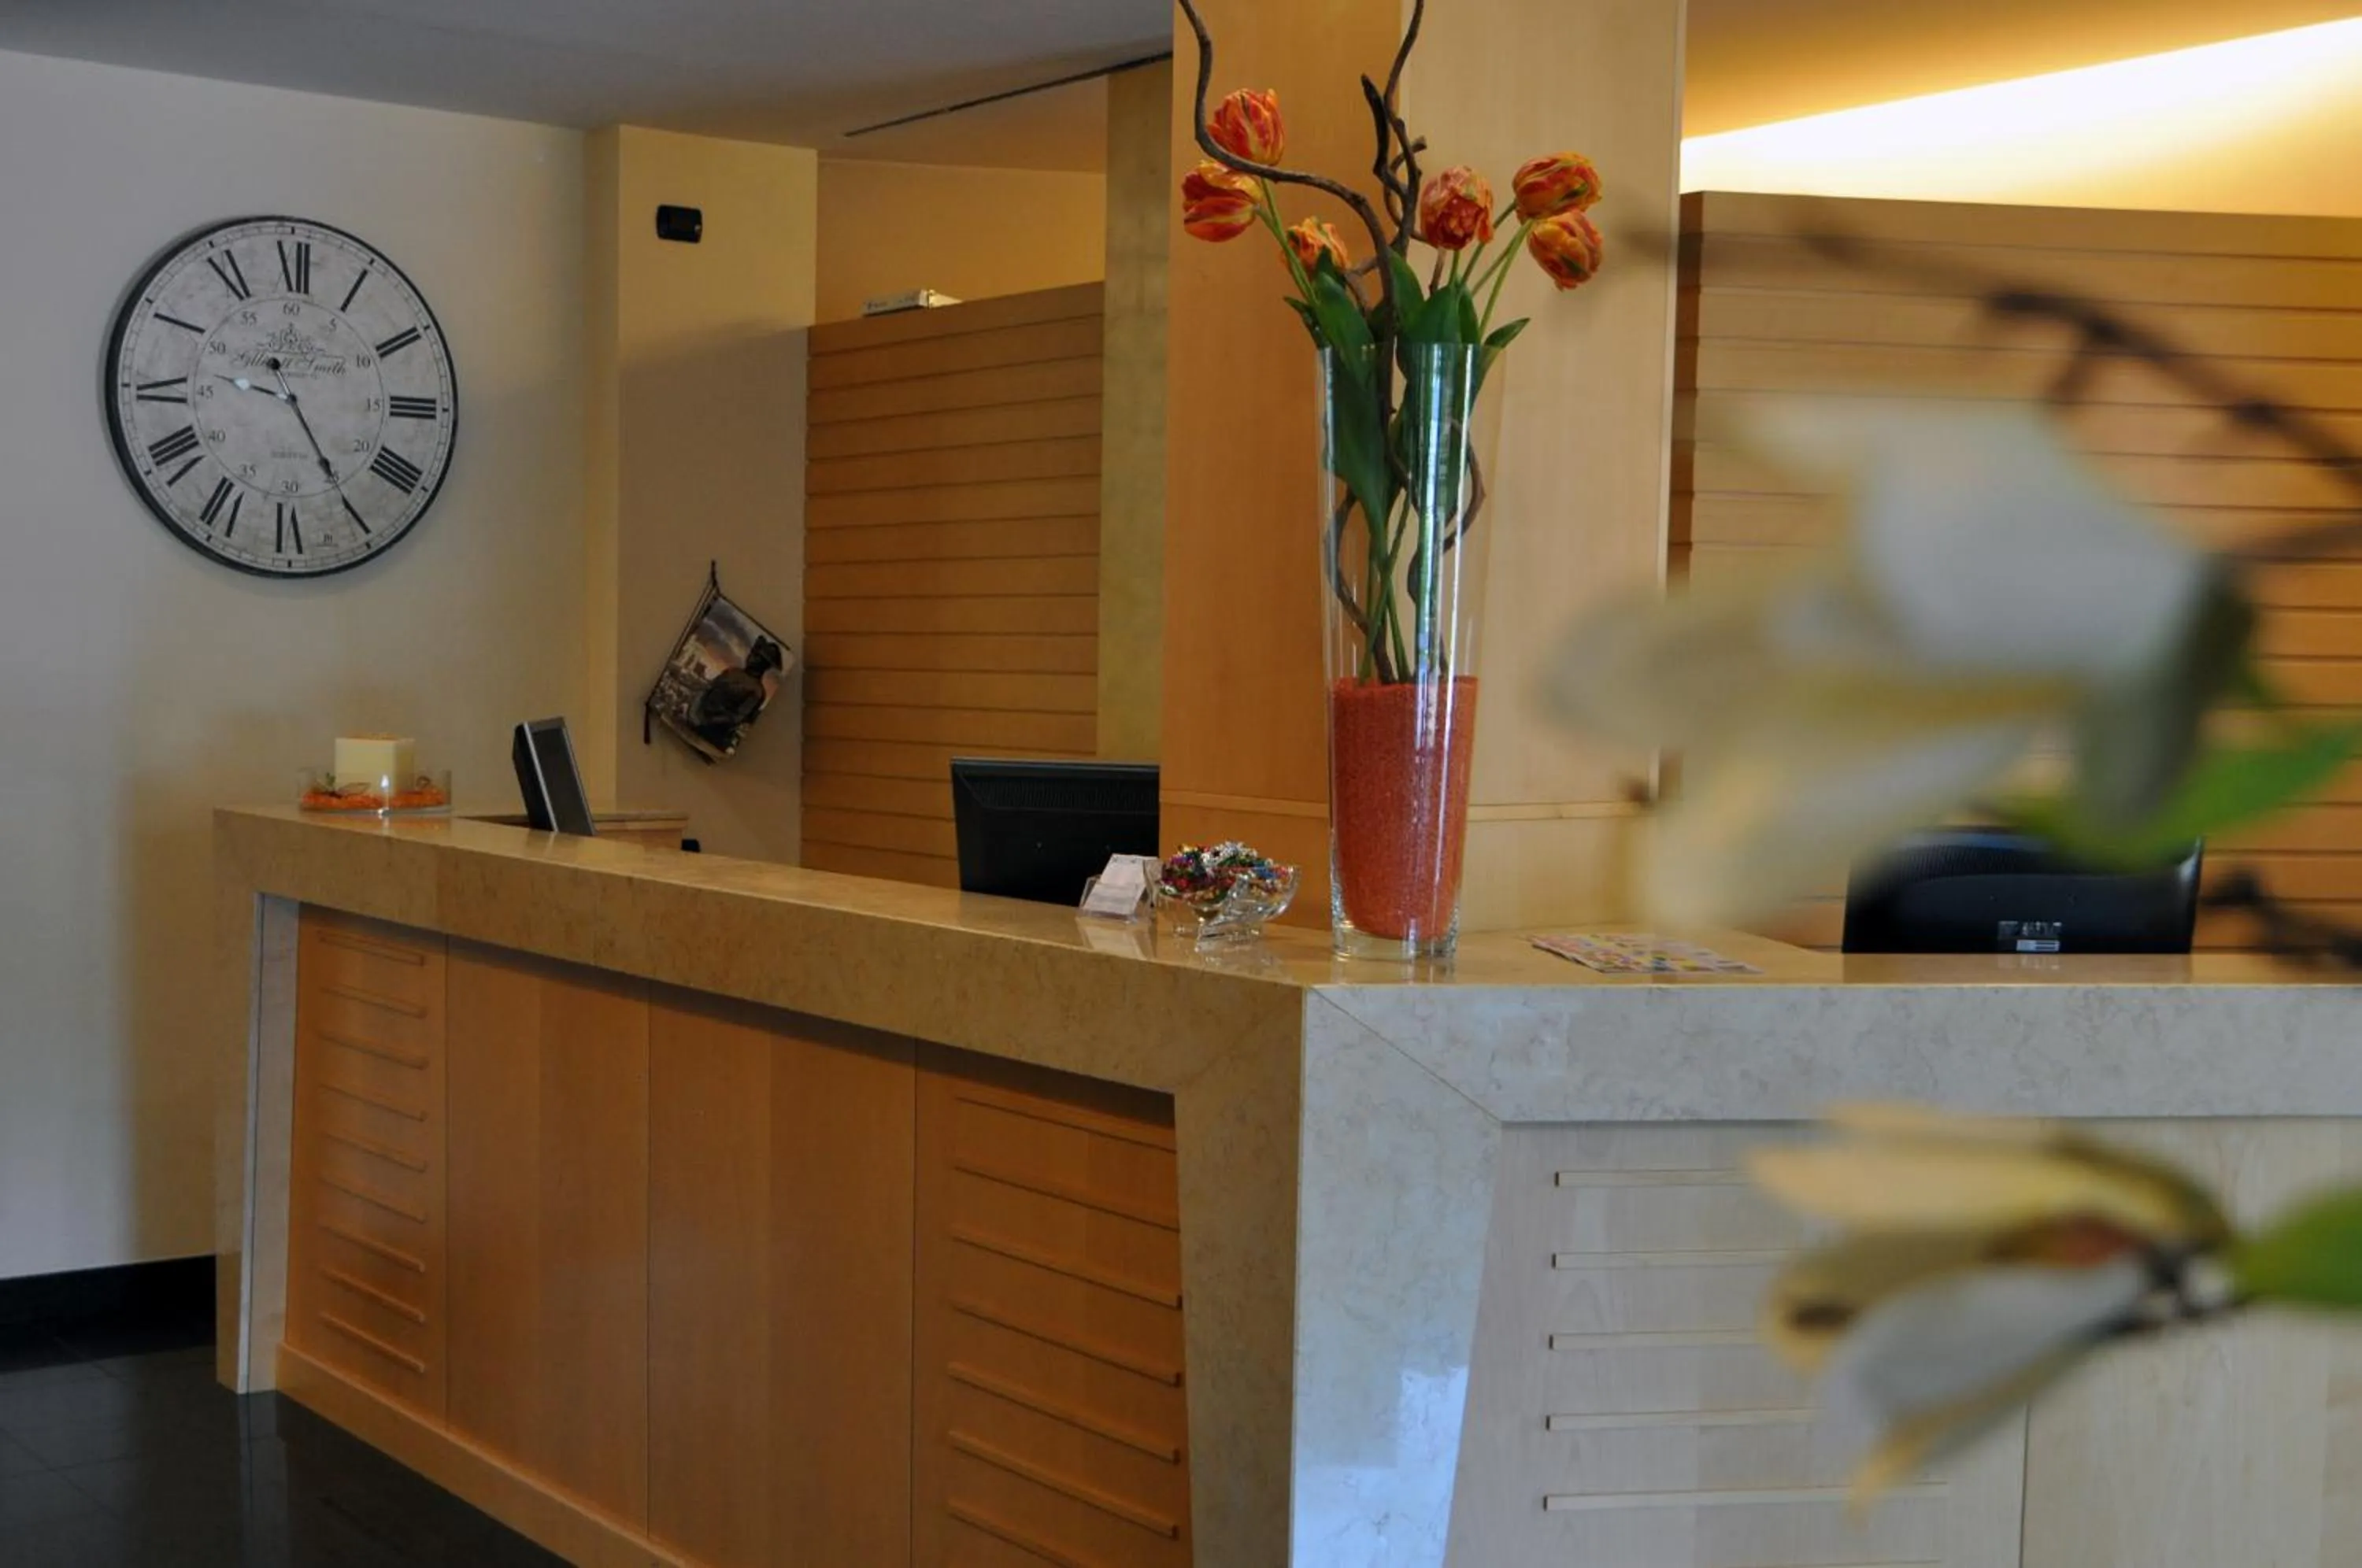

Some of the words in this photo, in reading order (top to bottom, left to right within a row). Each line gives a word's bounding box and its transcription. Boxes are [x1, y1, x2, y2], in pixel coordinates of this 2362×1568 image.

[283, 303, 300, 316] 60
[241, 310, 257, 326] 55
[328, 317, 338, 334] 5
[209, 341, 227, 354] 50
[355, 354, 371, 369] 10
[198, 385, 214, 400] 45
[365, 397, 380, 412] 15
[208, 430, 227, 443] 40
[354, 439, 370, 453] 20
[239, 464, 257, 479] 35
[281, 480, 299, 494] 30
